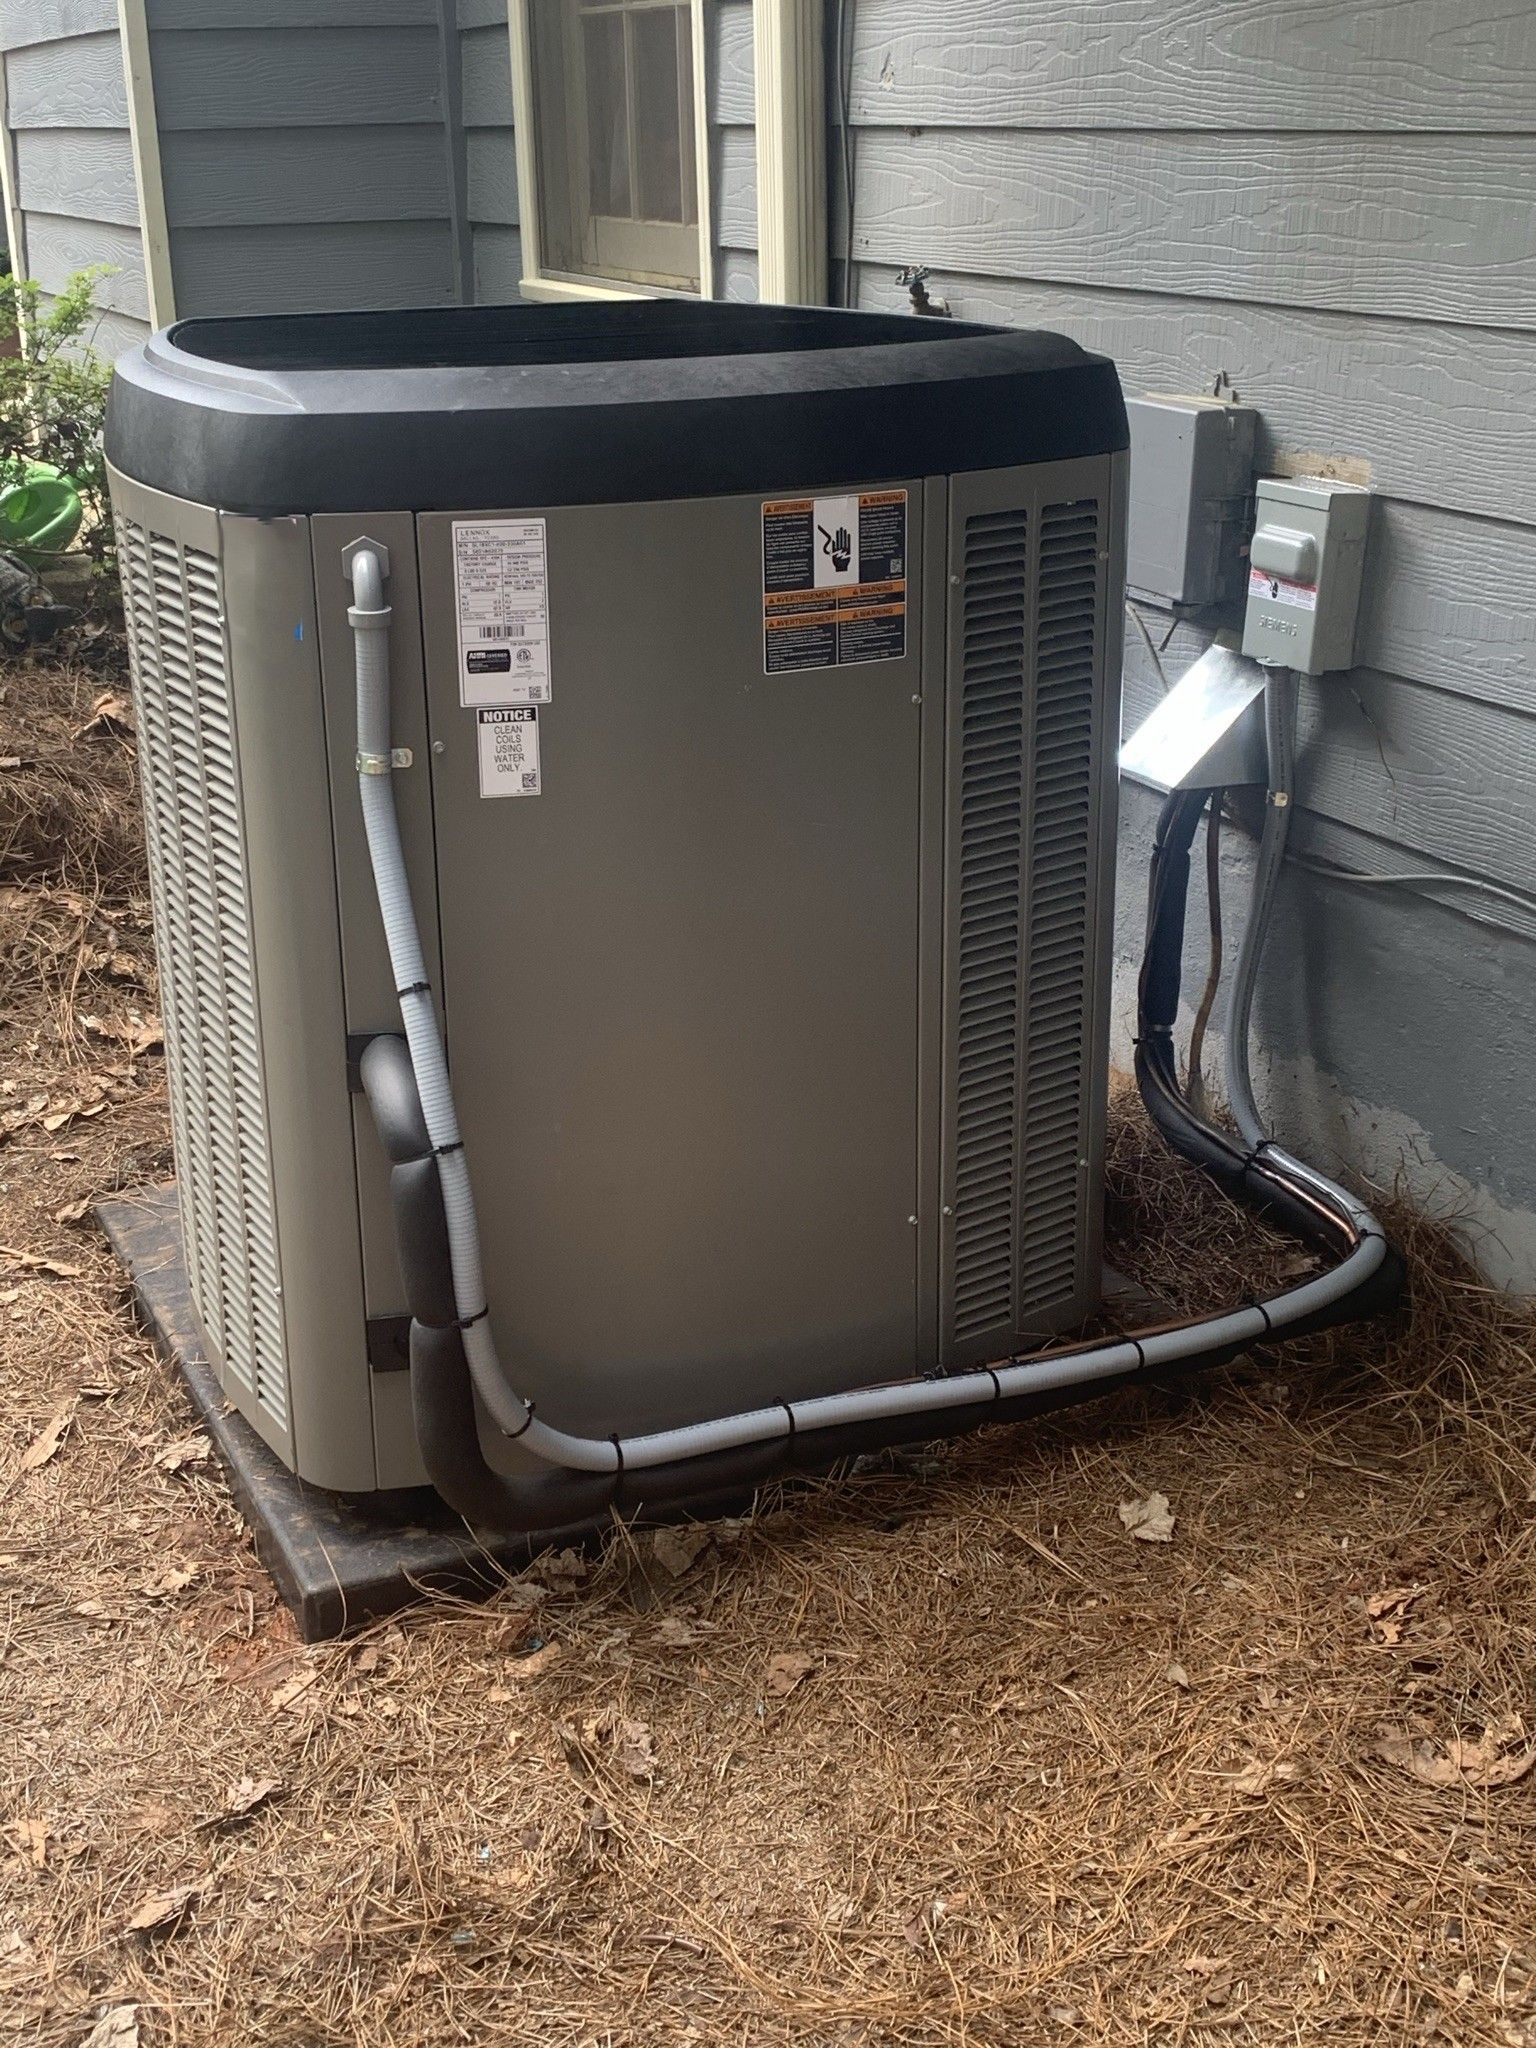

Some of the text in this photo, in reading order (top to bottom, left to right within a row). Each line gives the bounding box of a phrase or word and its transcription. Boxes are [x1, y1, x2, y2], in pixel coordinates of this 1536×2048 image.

[870, 494, 904, 504] WARNING
[860, 584, 893, 594] WARNING
[860, 608, 893, 618] WARNING
[483, 709, 532, 722] NOTICE
[494, 725, 522, 734] CLEAN
[496, 735, 521, 744] COILS
[495, 744, 522, 753] USING
[494, 754, 525, 763] WATER
